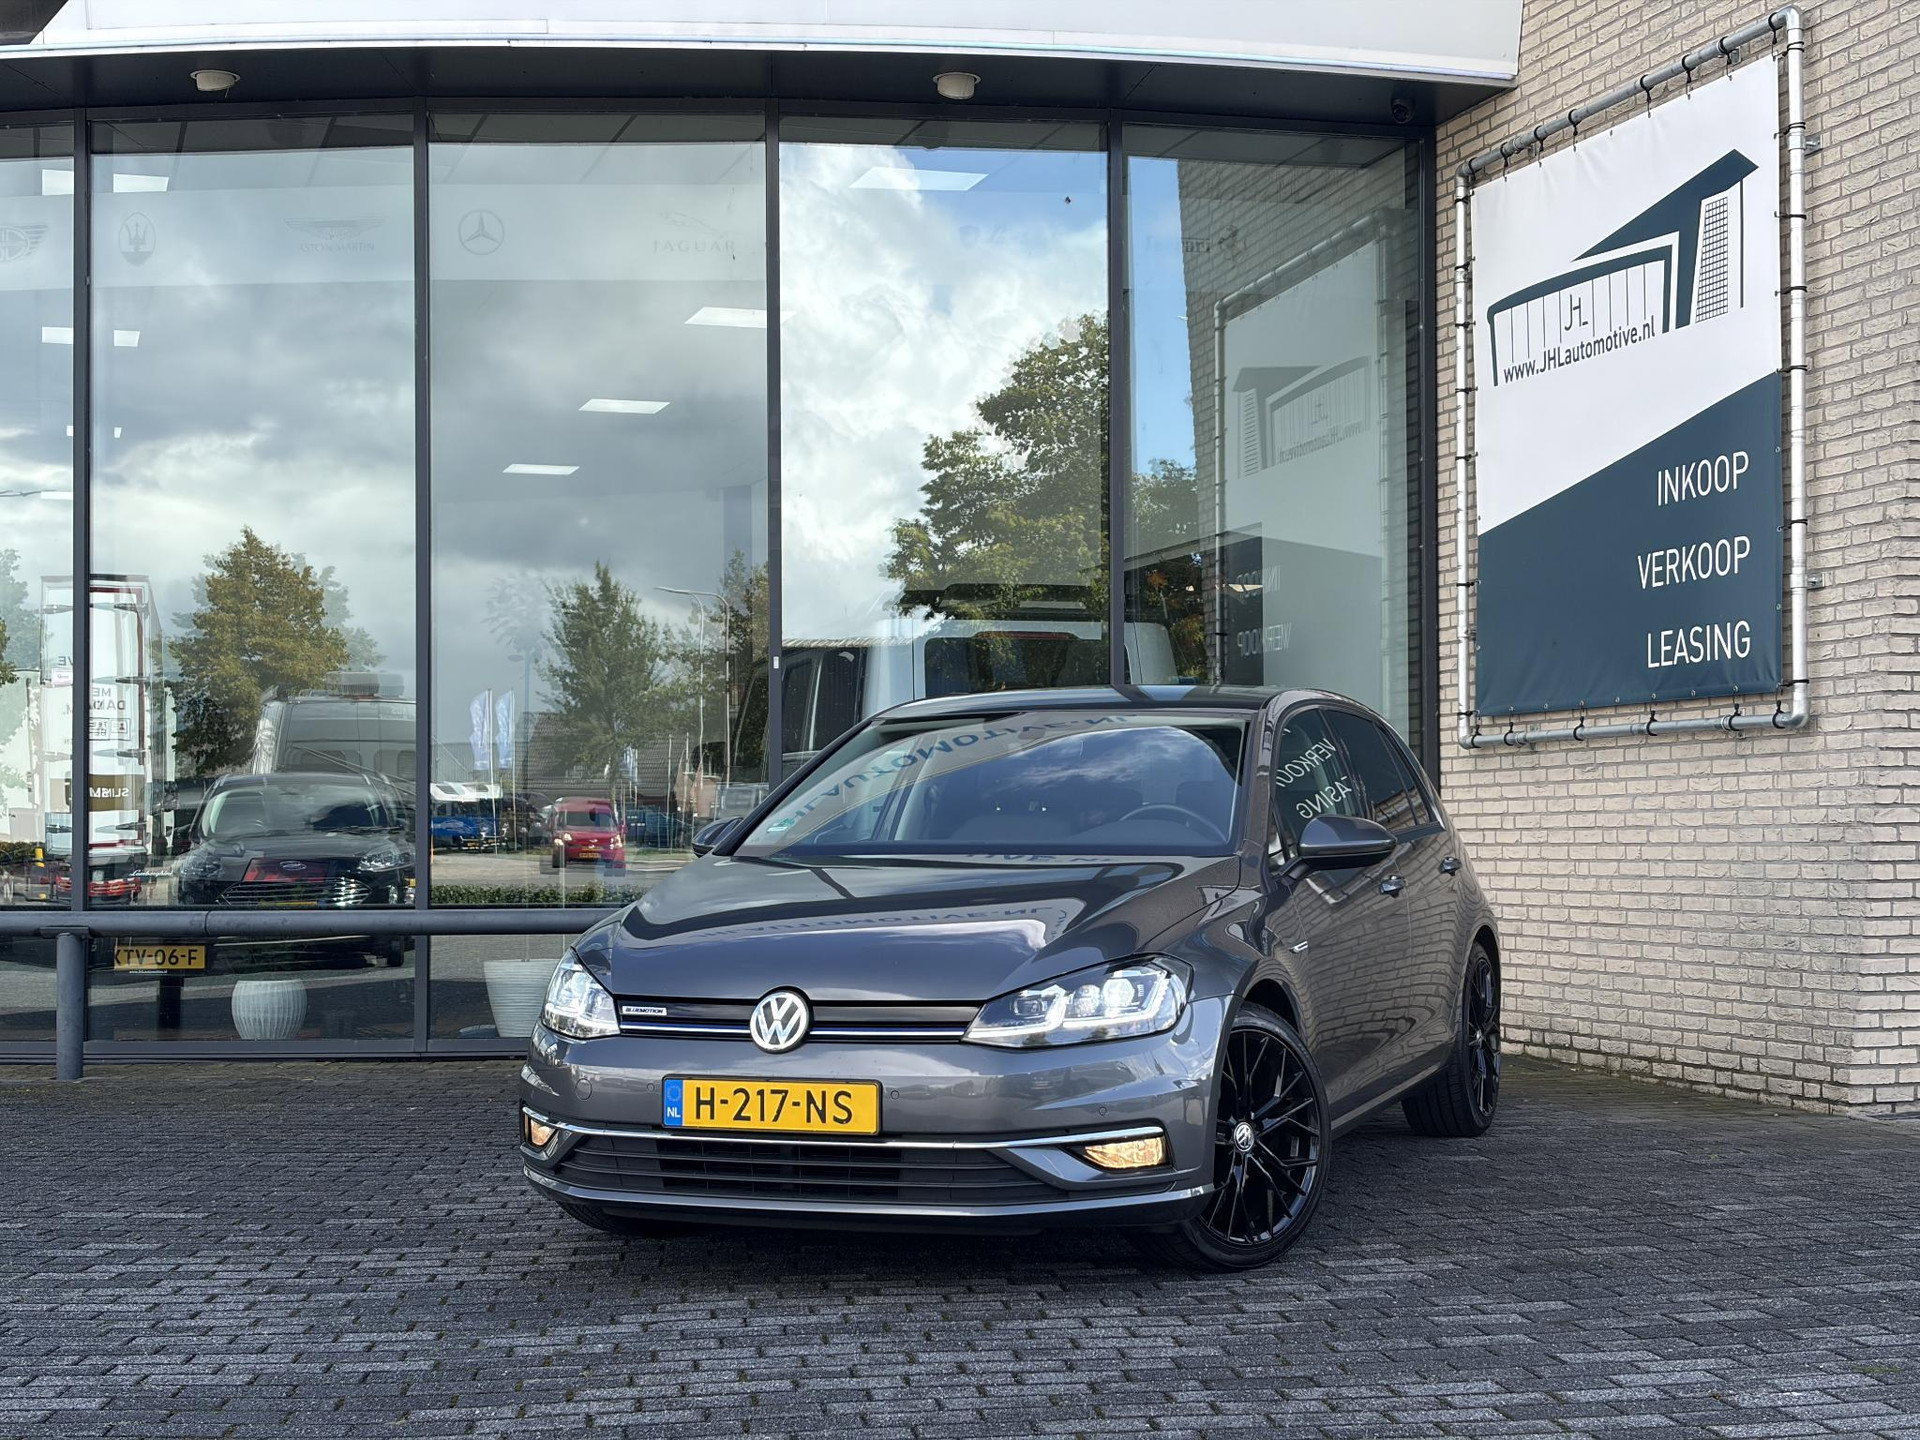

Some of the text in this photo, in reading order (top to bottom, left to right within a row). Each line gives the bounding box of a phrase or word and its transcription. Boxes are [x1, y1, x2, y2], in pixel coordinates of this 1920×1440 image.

[652, 239, 735, 253] JAGUAR
[1503, 316, 1656, 384] www.JHLautomotive.nl
[1657, 450, 1750, 507] INKOOP
[1637, 535, 1751, 589] VERKOOP
[1647, 620, 1752, 668] LEASING
[667, 1107, 681, 1118] NL
[694, 1086, 853, 1125] H-217-NS
